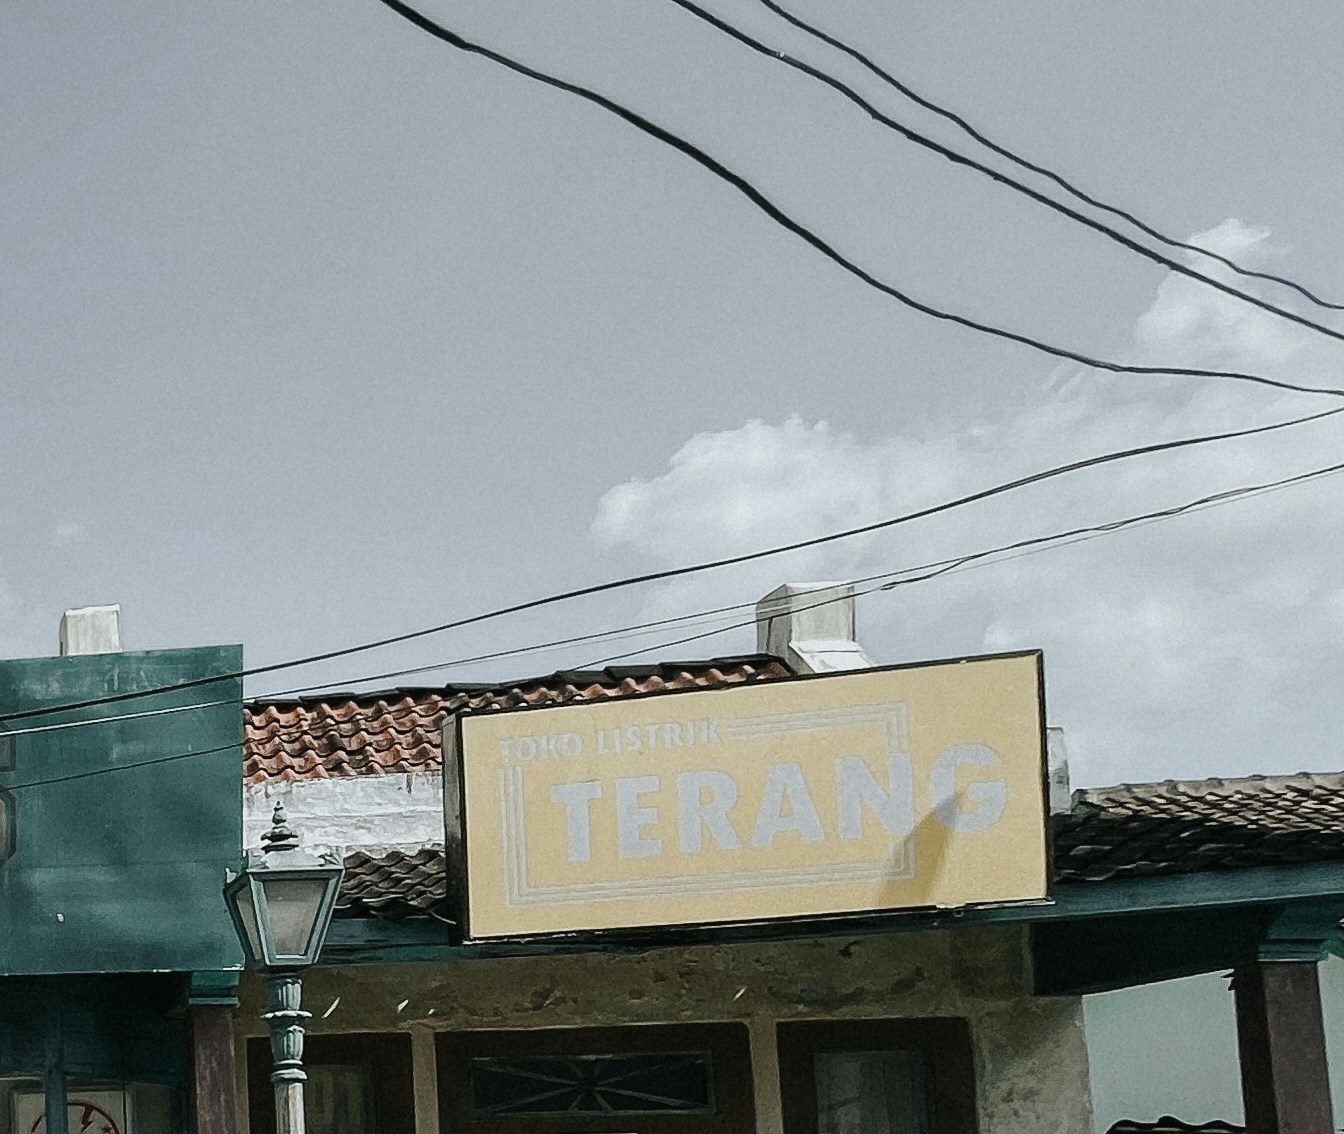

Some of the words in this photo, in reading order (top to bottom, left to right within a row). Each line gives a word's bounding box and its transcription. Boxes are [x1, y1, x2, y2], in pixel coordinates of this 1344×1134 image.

[499, 732, 583, 763] TOKO
[598, 718, 721, 754] LISTRIK
[551, 741, 1007, 864] TERANG
